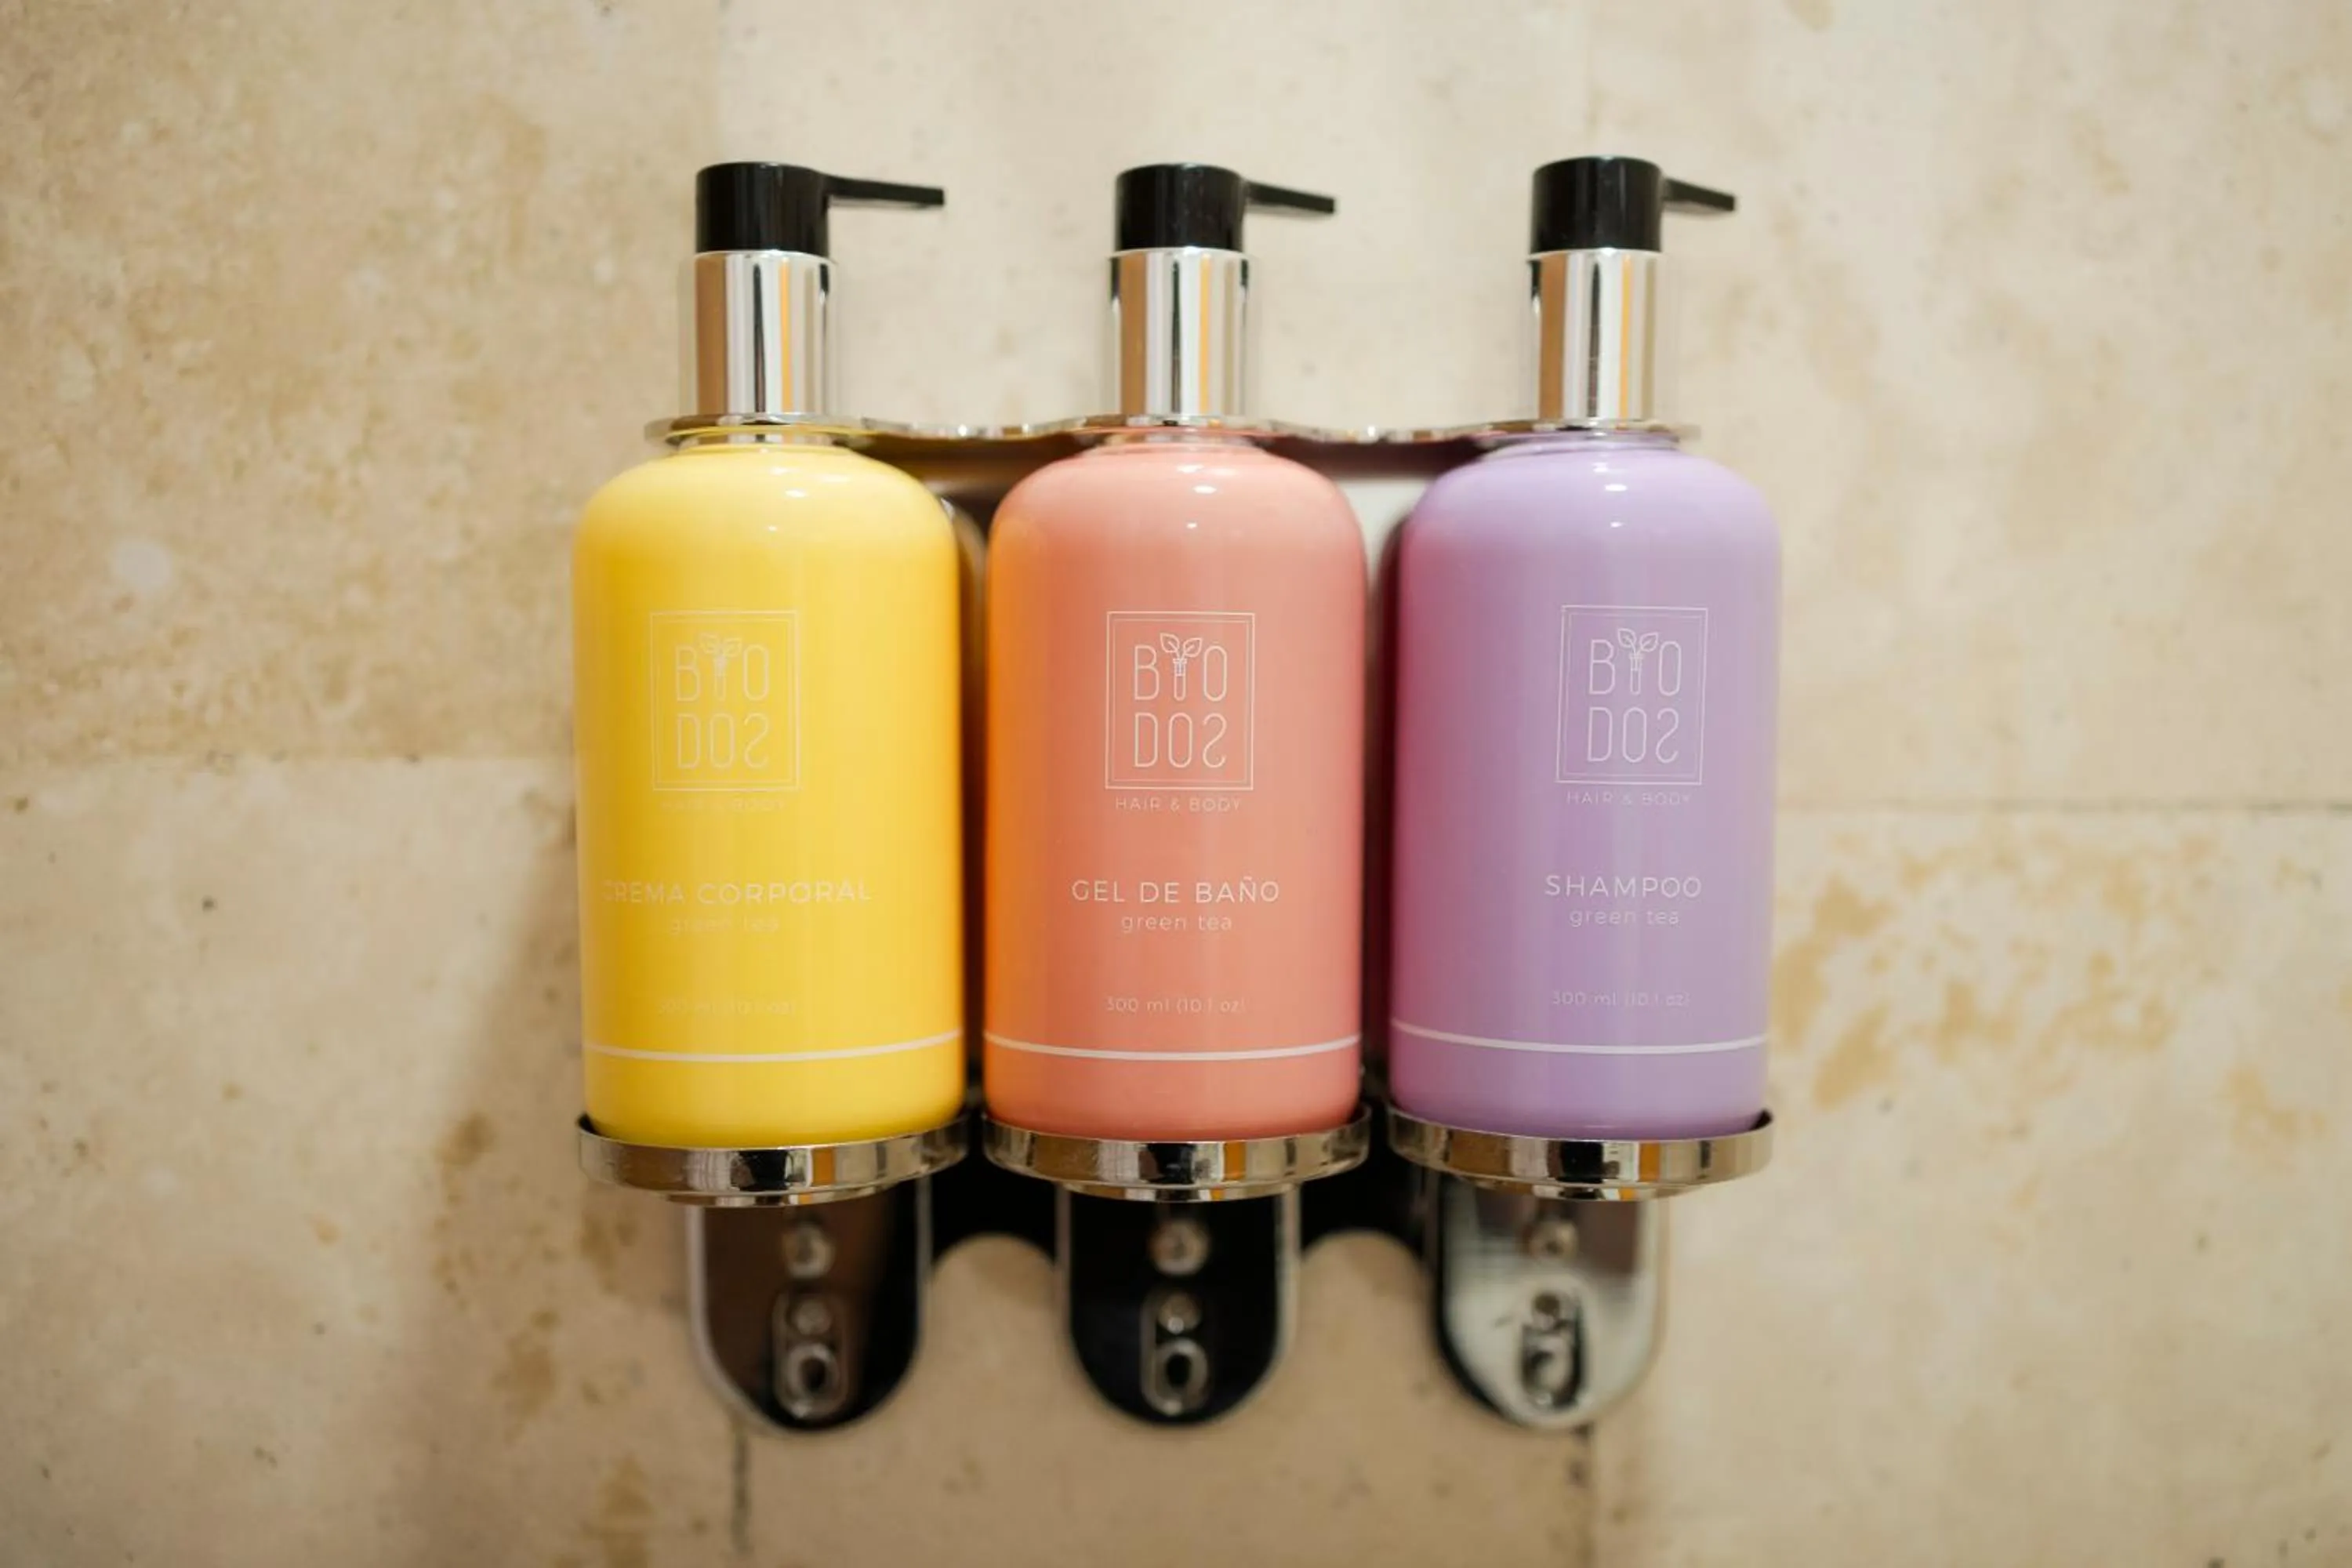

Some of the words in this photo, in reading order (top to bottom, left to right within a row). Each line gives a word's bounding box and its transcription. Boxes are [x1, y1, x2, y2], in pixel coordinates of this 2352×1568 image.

[1116, 797, 1161, 811] HAIR
[1170, 797, 1180, 812] &
[1189, 797, 1242, 812] BODY
[1566, 790, 1614, 806] HAIR
[1642, 791, 1692, 807] BODY
[602, 879, 687, 906] CREMA
[696, 876, 873, 906] CORPORAL
[1071, 880, 1125, 902] GEL
[1139, 881, 1181, 904] DE
[1195, 875, 1279, 904] BAÑO
[1544, 874, 1702, 899] SHAMPOO
[1121, 915, 1187, 934] green
[1198, 914, 1232, 932] tea
[1569, 909, 1636, 927] green
[1646, 909, 1679, 926] tea
[1146, 996, 1170, 1013] ml
[1594, 990, 1617, 1007] ml
